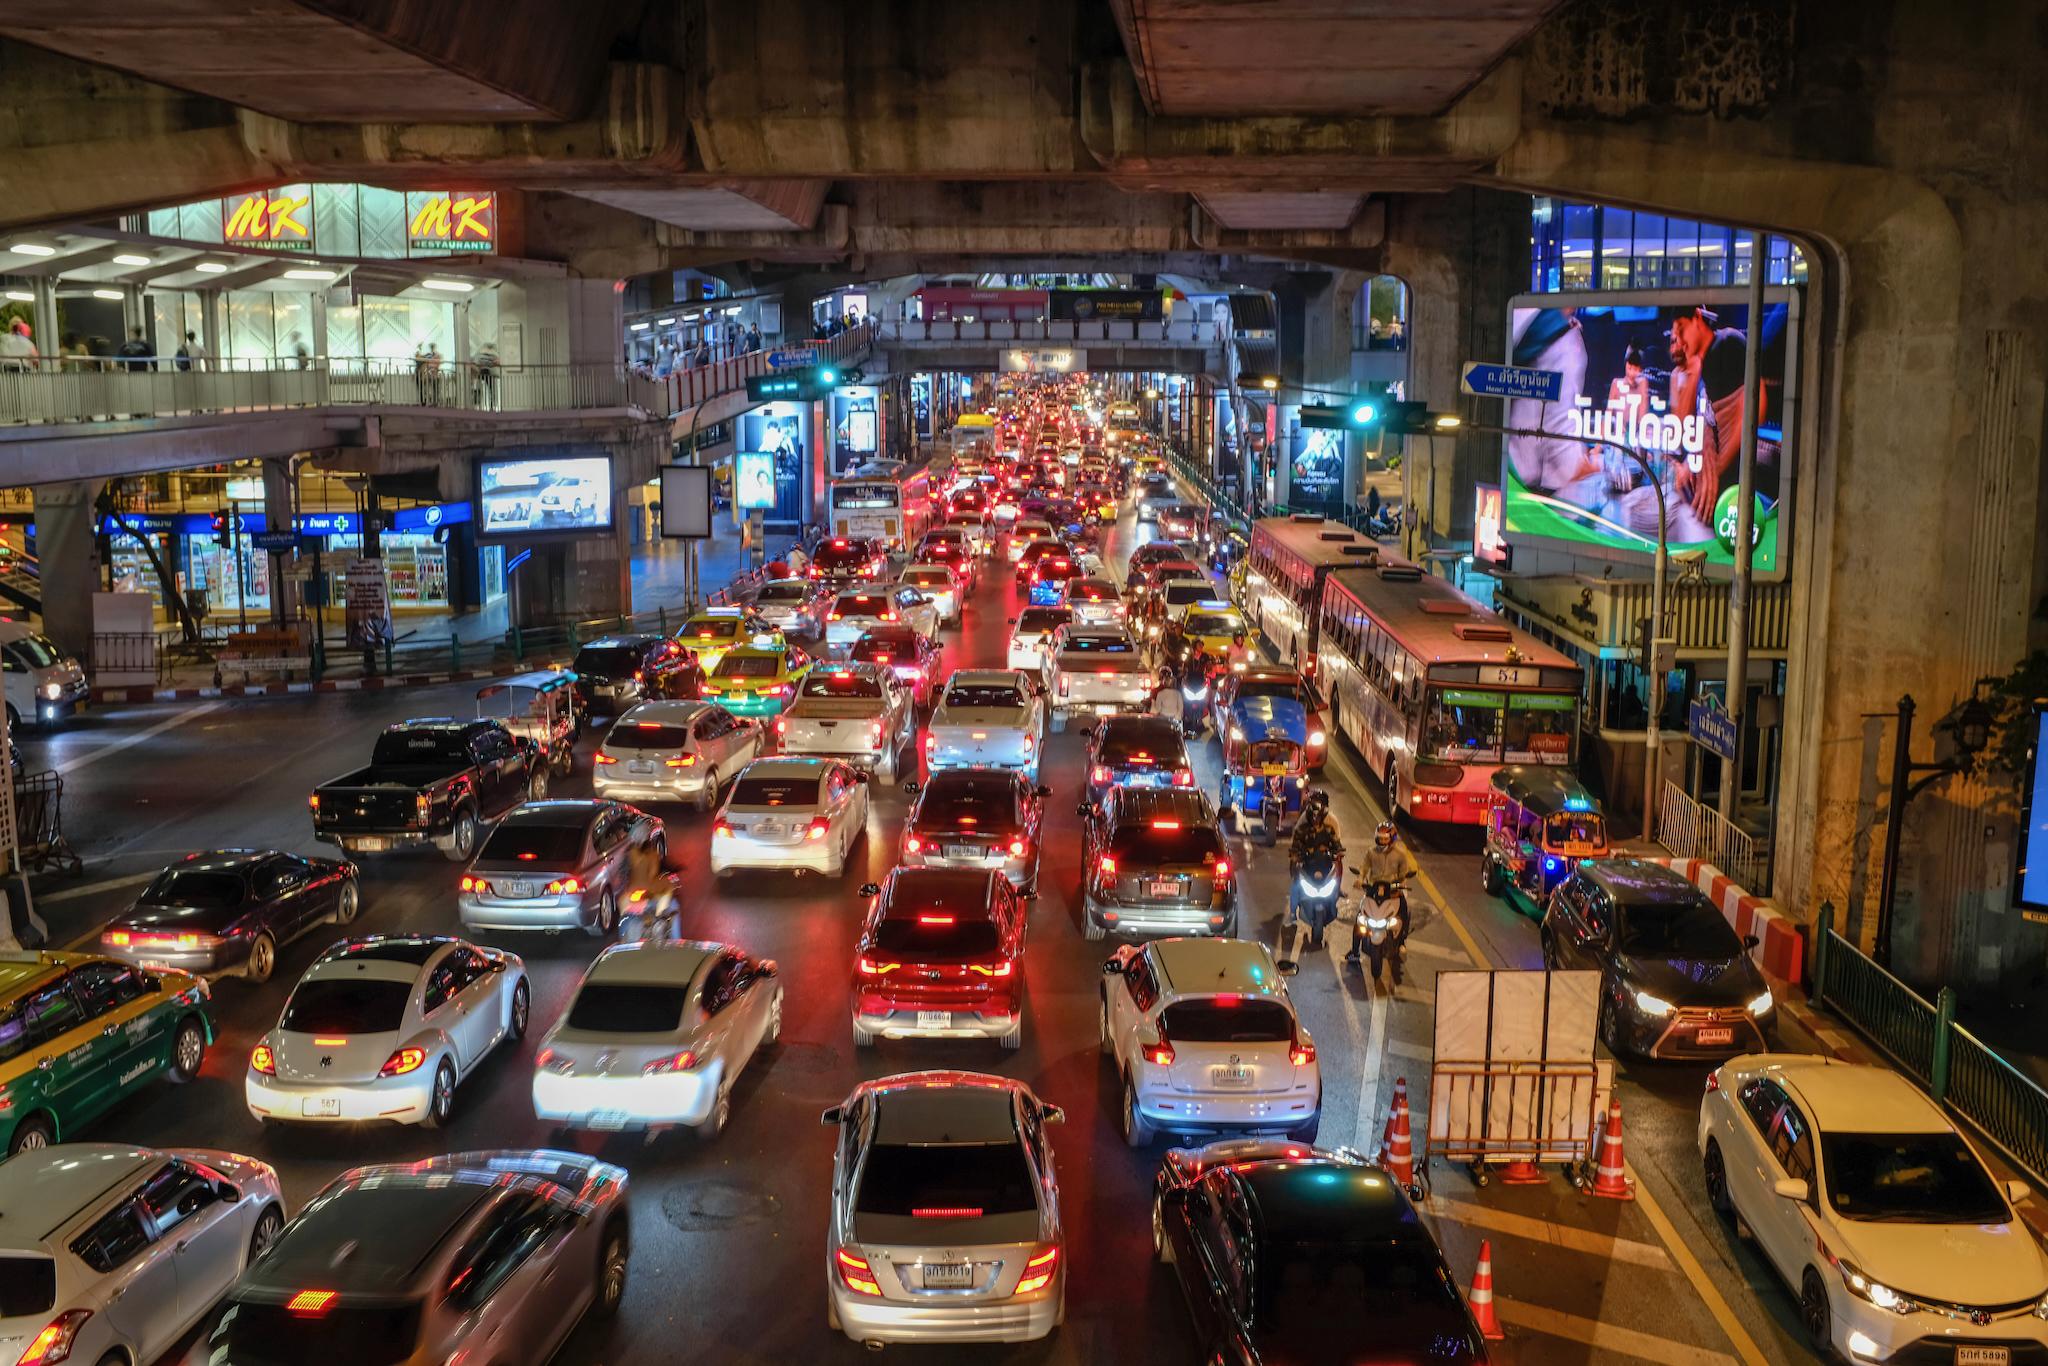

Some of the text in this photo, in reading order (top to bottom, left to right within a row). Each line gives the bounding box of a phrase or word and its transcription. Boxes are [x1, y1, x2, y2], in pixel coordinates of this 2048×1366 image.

[225, 196, 309, 238] MK
[410, 197, 491, 238] MK
[1486, 385, 1504, 394] Henri
[1508, 387, 1532, 397] Dunant
[1567, 381, 1707, 474] วันนี้ได้อยู่
[1498, 669, 1519, 683] 54
